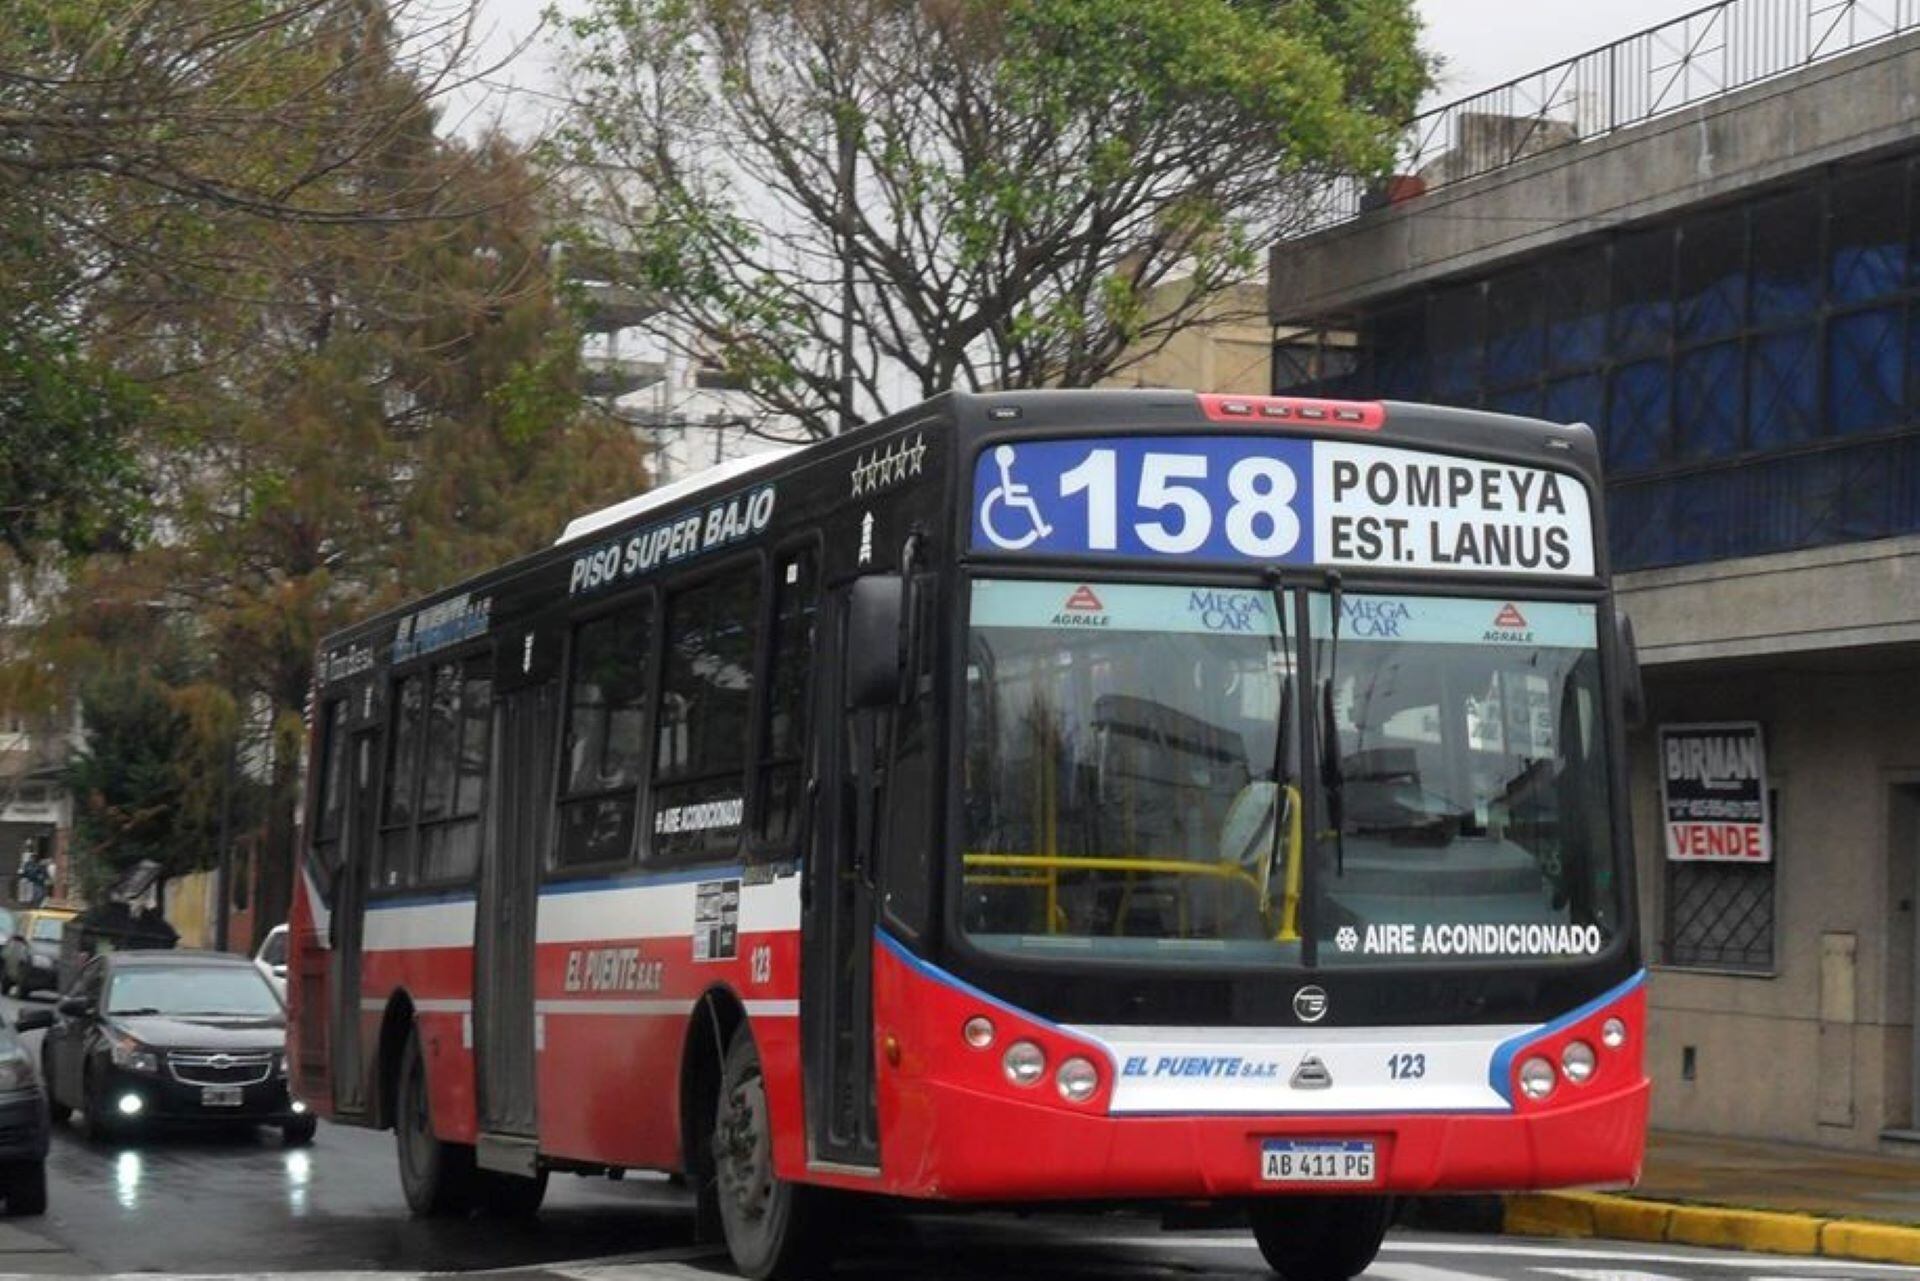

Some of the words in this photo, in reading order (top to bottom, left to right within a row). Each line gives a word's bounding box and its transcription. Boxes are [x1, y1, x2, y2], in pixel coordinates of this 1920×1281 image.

[1332, 460, 1566, 515] POMPEYA
[1060, 449, 1300, 558] 158
[569, 545, 621, 594] PISO
[623, 517, 701, 575] SUPER
[703, 487, 775, 547] BAJO
[1331, 516, 1414, 561] EST.
[1430, 521, 1570, 570] LANUS
[1188, 590, 1266, 614] MEGA
[1340, 598, 1412, 620] MEGA
[1051, 614, 1110, 627] AGRALE
[1202, 609, 1253, 631] CAR
[1350, 617, 1401, 637] CAR
[1482, 631, 1534, 643] AGRALE
[1666, 737, 1761, 786] BIRMAN
[1674, 824, 1762, 857] VENDE
[1364, 924, 1416, 954] AIRE
[1421, 924, 1600, 955] ACONDICIONADO
[565, 949, 582, 991] EL
[752, 946, 771, 983] 123
[1122, 1056, 1148, 1077] EL
[1153, 1056, 1242, 1078] PUENTE
[1388, 1053, 1426, 1080] 123
[1267, 1154, 1292, 1176] AB
[1299, 1154, 1338, 1176] 411
[1345, 1154, 1370, 1176] PG
